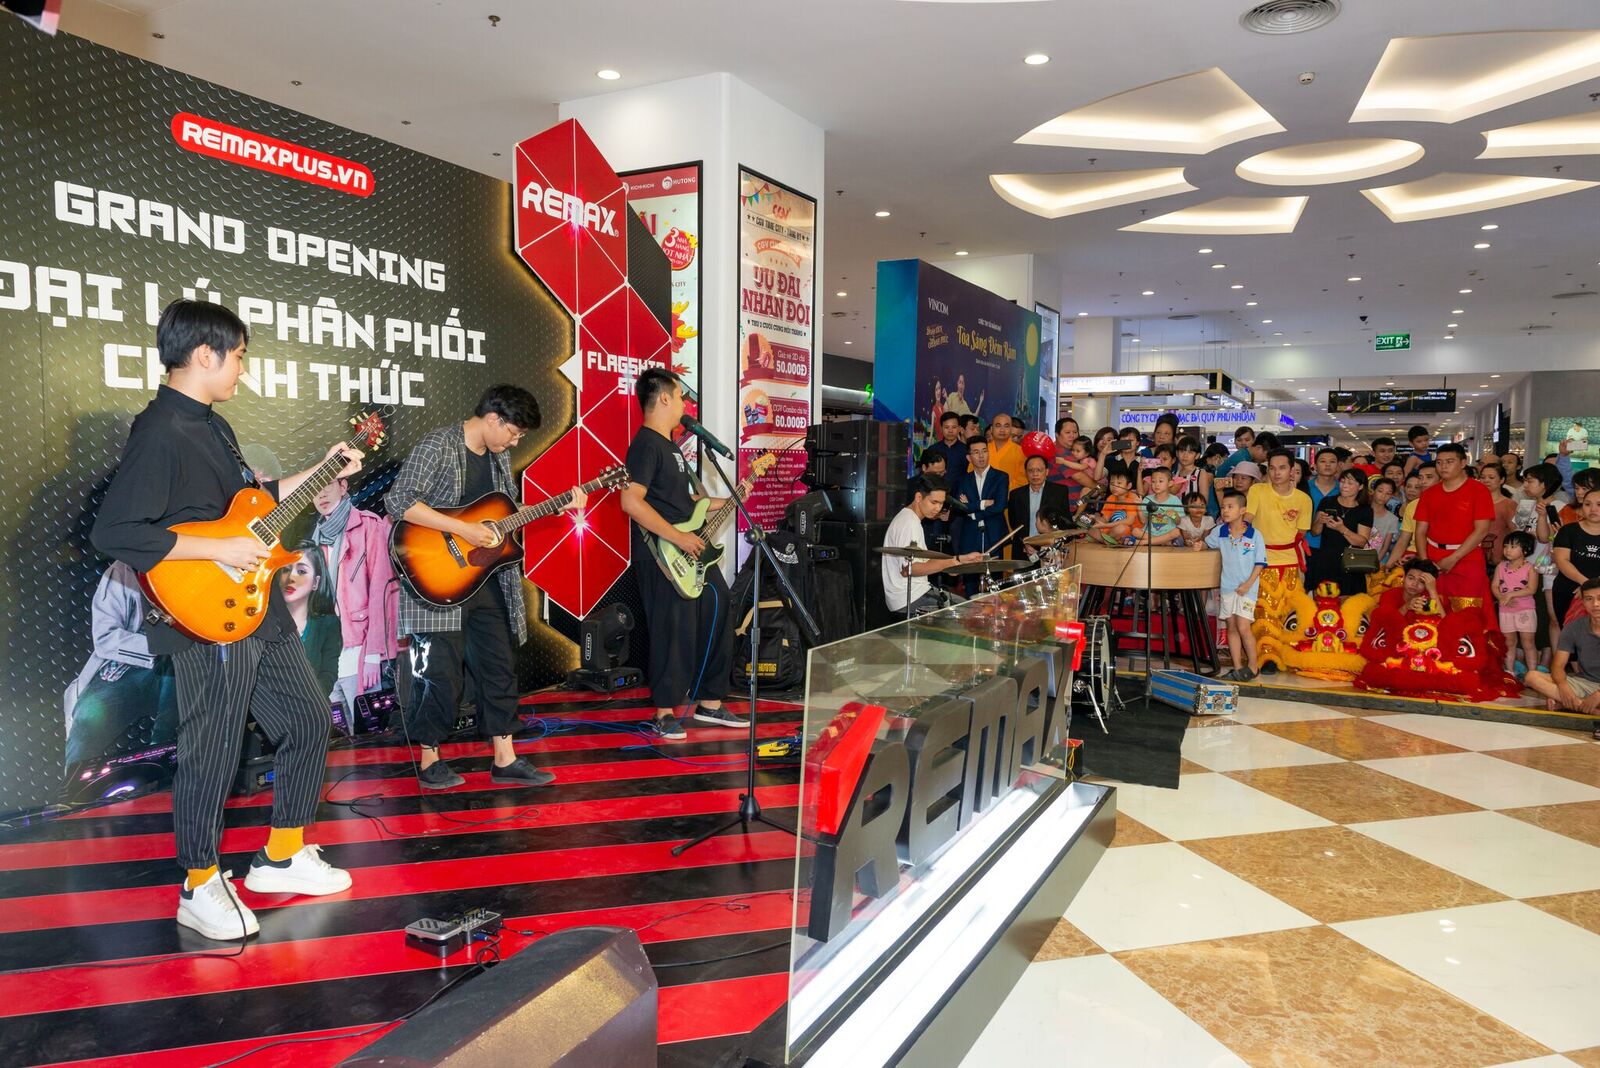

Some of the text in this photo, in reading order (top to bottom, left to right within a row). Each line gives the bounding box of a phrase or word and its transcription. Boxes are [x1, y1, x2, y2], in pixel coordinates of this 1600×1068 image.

[672, 176, 697, 185] HUTONG
[522, 181, 616, 236] REMAX
[54, 180, 446, 293] GRAND OPENING
[664, 226, 680, 248] 3
[927, 297, 949, 315] VINCOM
[145, 277, 221, 326] L
[238, 296, 375, 351] PHÂN
[385, 307, 487, 365] PHỐI
[1376, 336, 1395, 345] EXIT
[776, 360, 808, 377] 50.000Đ
[309, 358, 426, 407] THỨC
[775, 414, 807, 428] 60.000Đ
